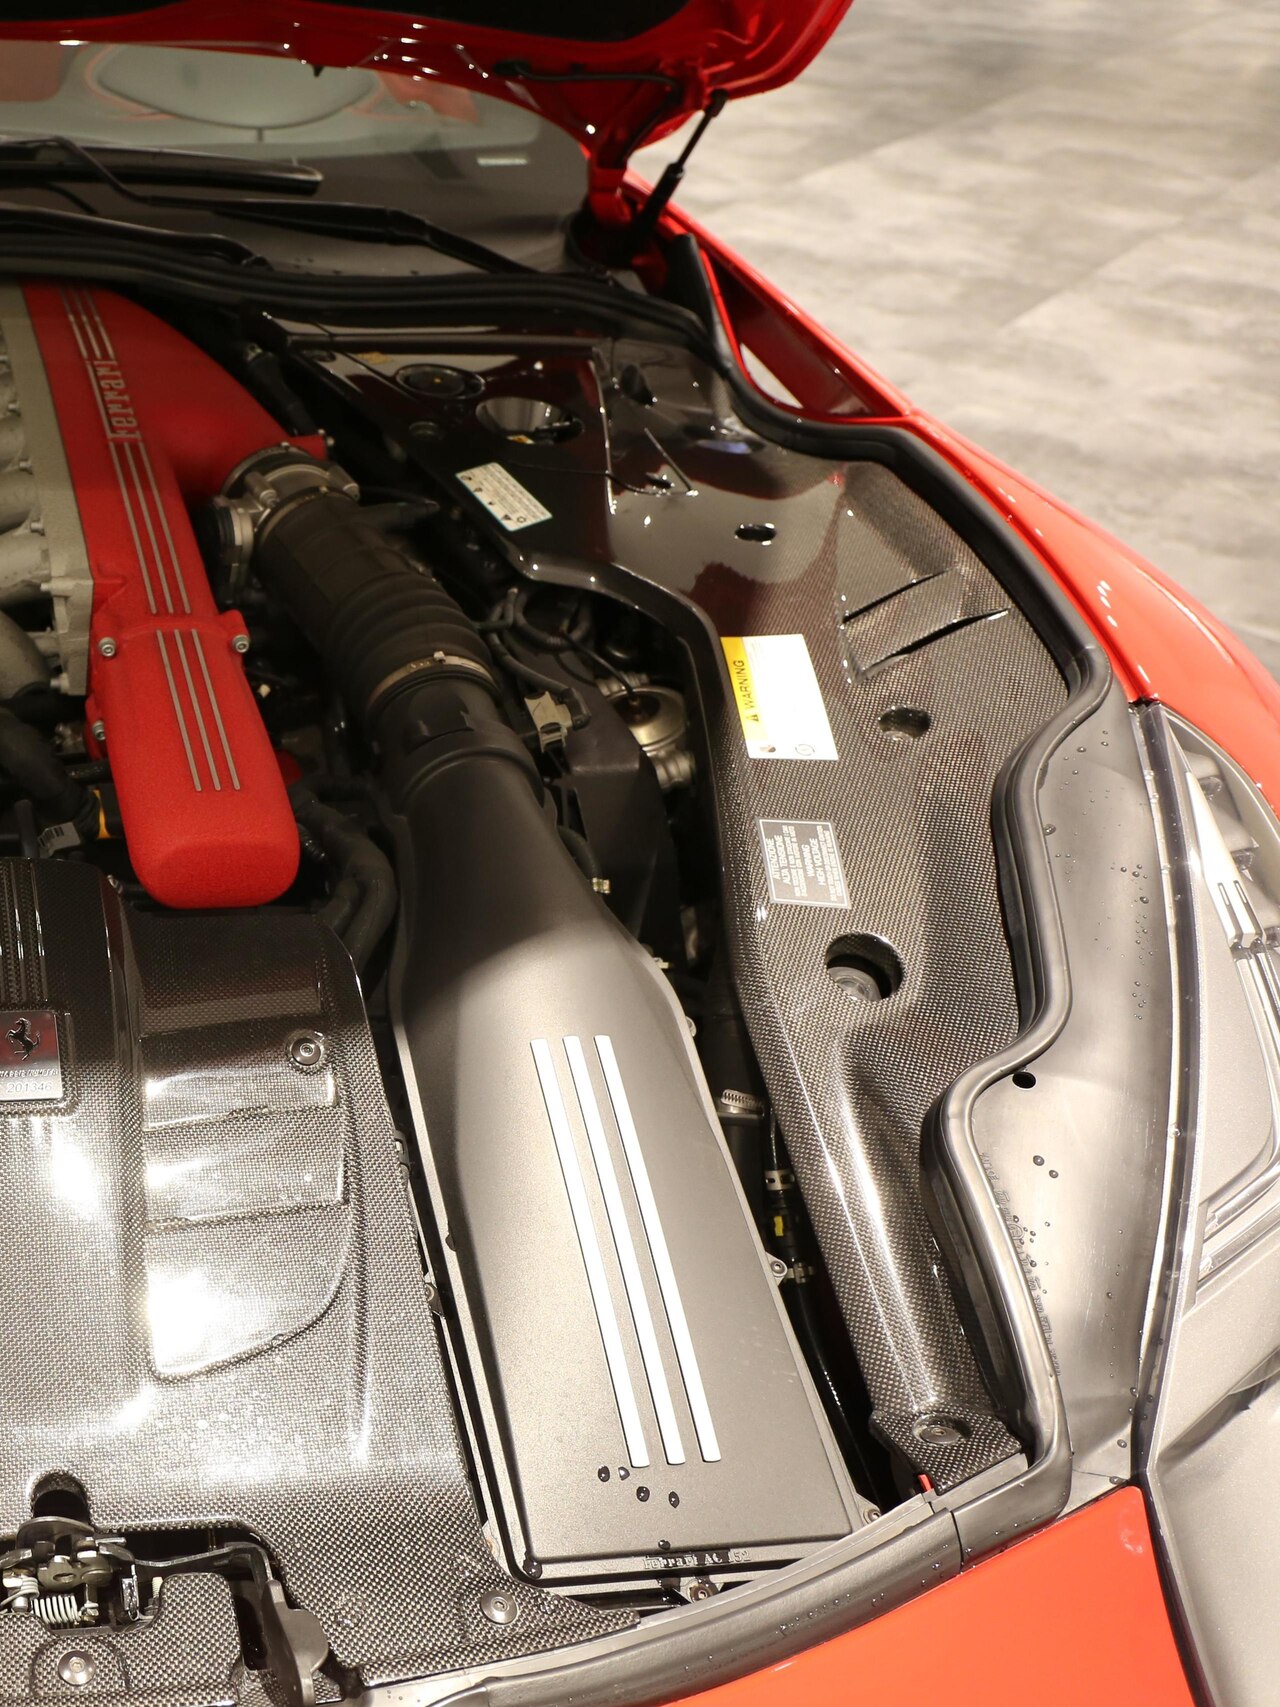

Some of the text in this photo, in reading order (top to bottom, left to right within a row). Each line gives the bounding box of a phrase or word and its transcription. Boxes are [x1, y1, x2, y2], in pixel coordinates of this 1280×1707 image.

[86, 360, 142, 439] Ferrari
[733, 660, 755, 710] WARNING
[765, 837, 781, 879] ATTENZIONE
[773, 834, 788, 867] TENSIONE
[800, 844, 815, 876] WARNING
[809, 838, 826, 885] HIGH VOLTAGE
[780, 868, 791, 884] ALTA
[6, 1081, 53, 1093] 201346
